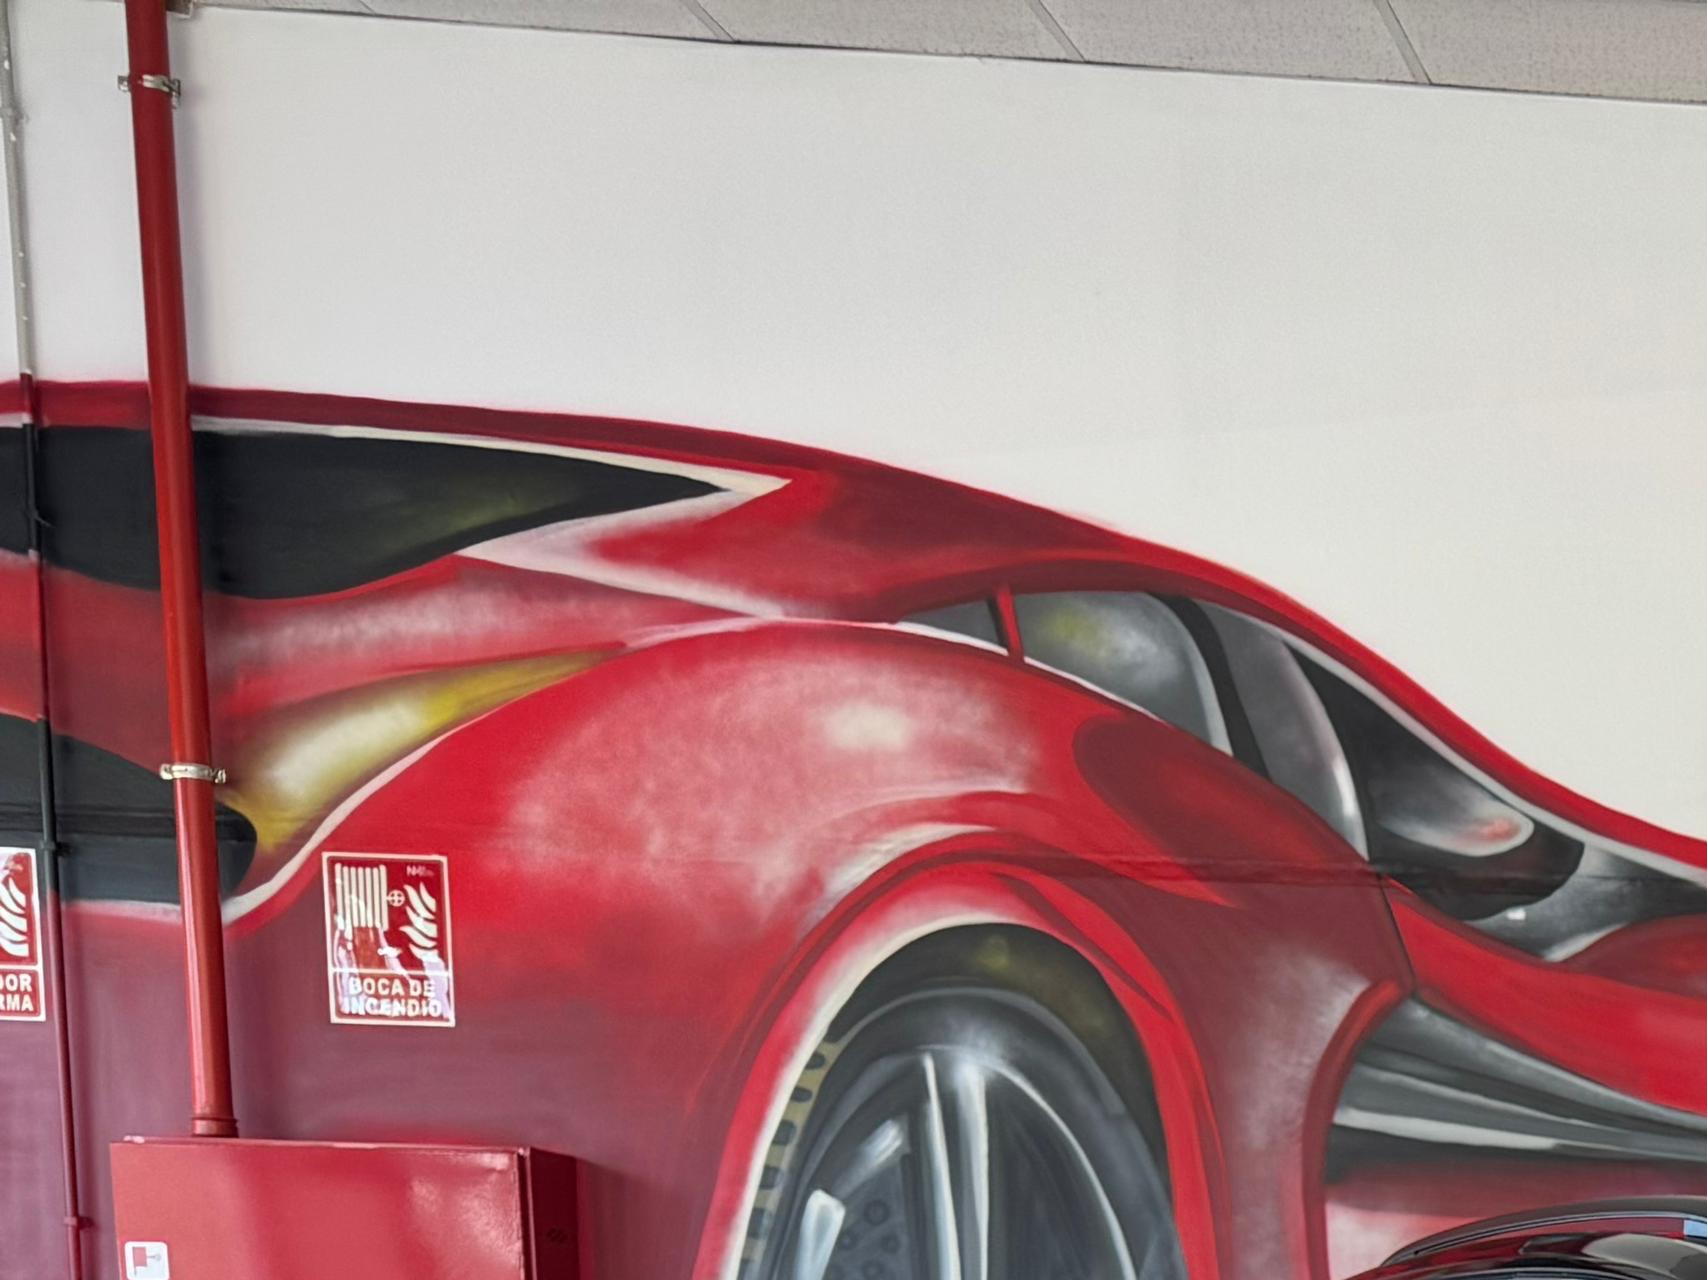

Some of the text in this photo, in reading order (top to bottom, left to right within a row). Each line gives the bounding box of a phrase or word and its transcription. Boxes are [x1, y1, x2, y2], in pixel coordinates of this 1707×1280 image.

[0, 972, 33, 993] OR
[349, 976, 436, 998] BOCA DE
[342, 998, 442, 1017] INCENDIO
